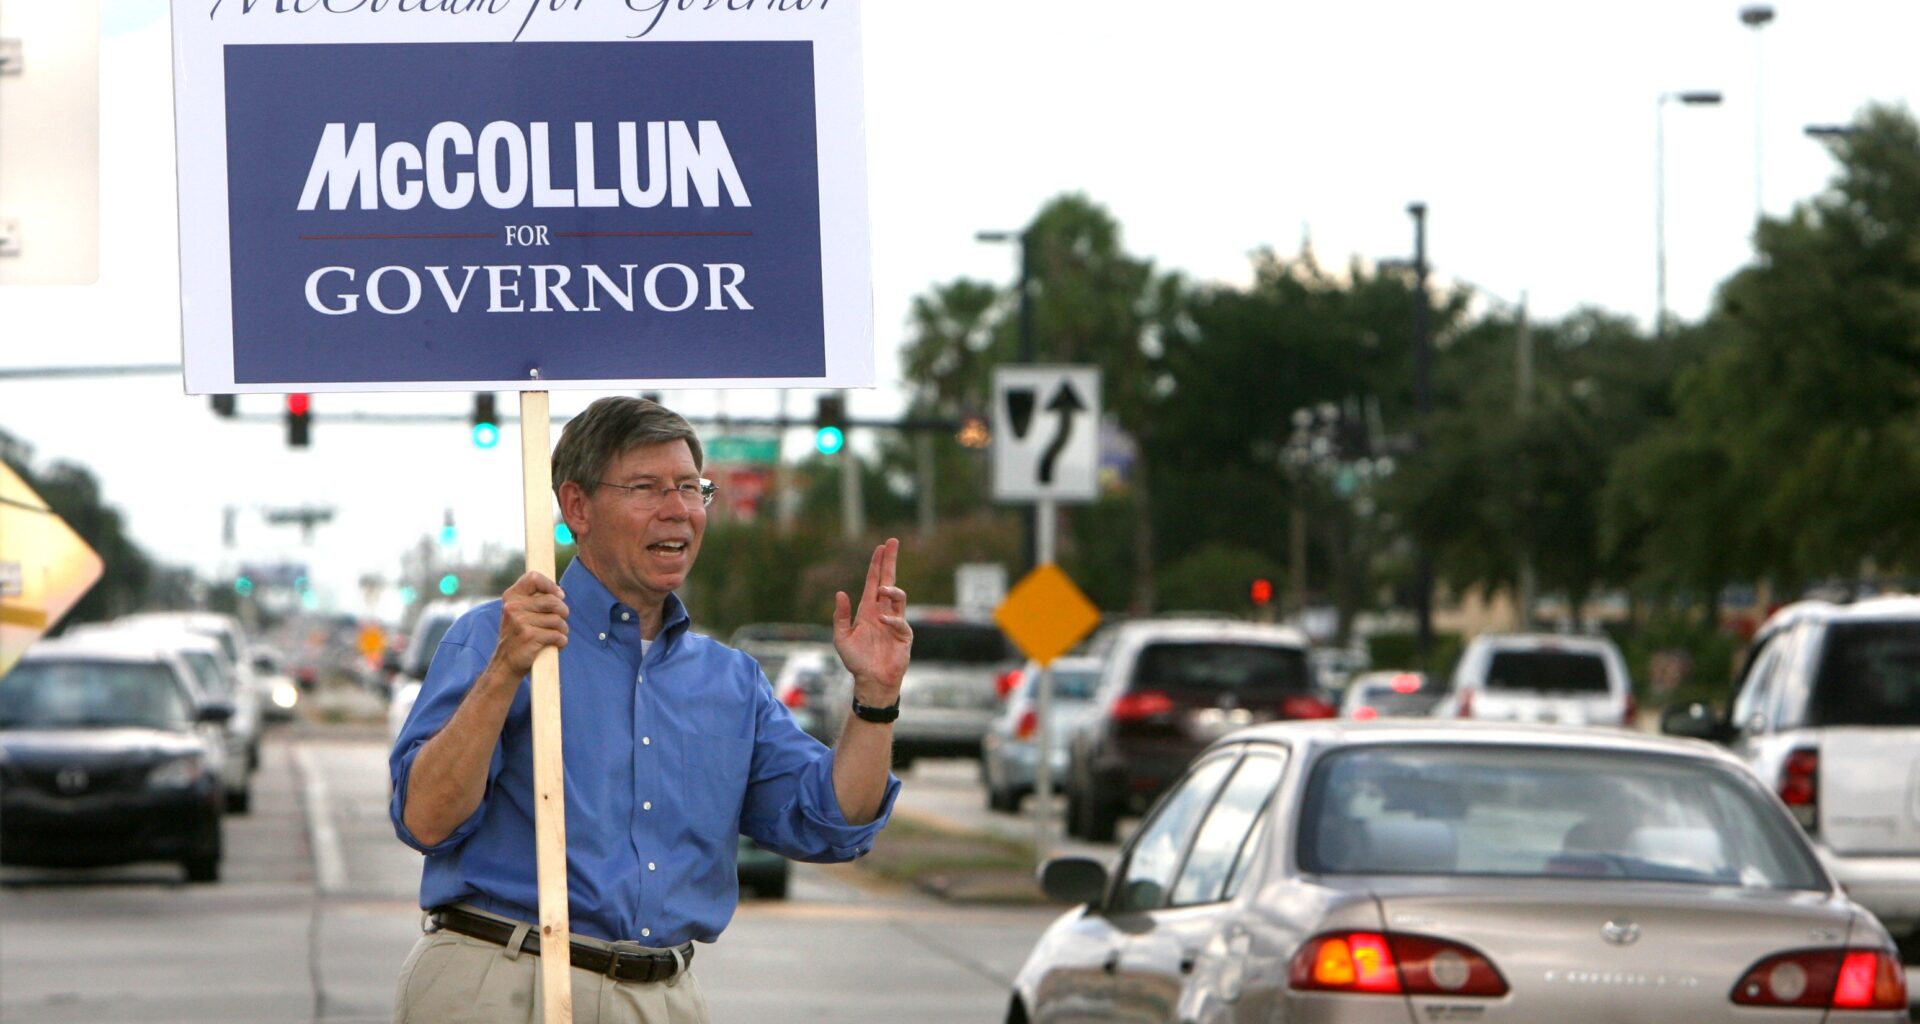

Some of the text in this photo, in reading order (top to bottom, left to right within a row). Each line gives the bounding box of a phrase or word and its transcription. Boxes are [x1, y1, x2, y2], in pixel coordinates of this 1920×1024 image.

[296, 120, 752, 211] McCOLLUM
[504, 225, 550, 246] FOR
[304, 263, 754, 315] GOVERNOR
